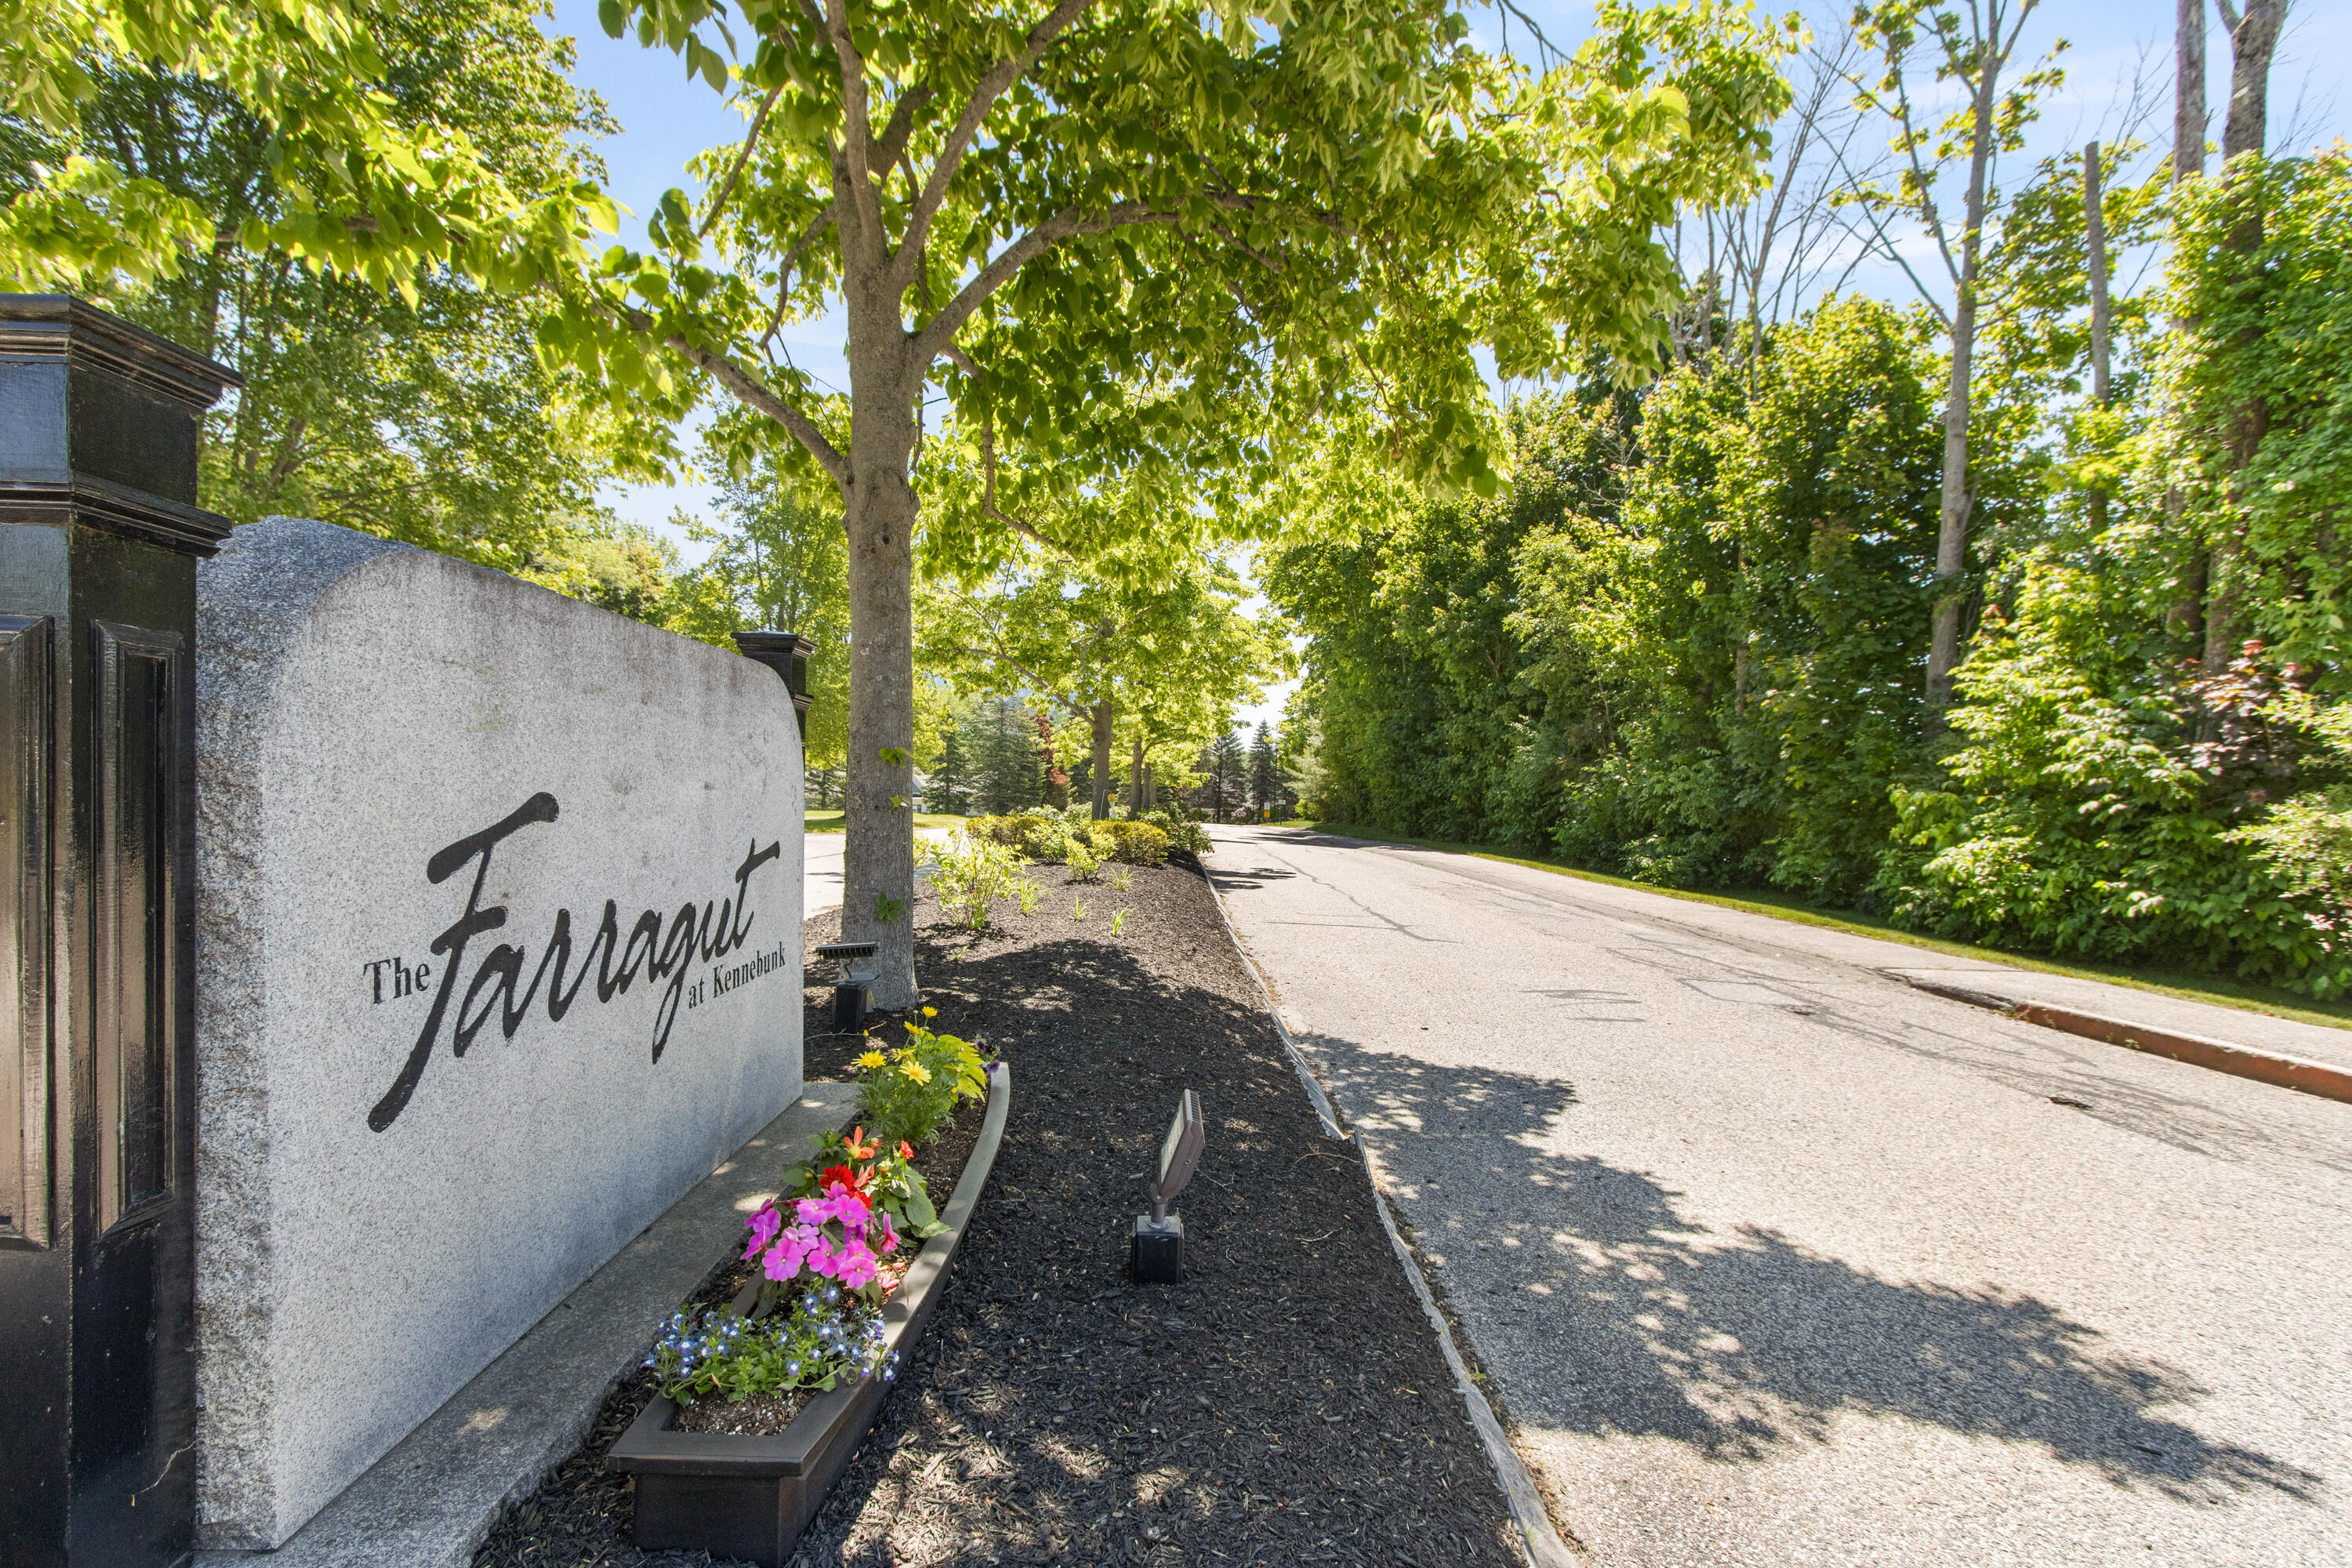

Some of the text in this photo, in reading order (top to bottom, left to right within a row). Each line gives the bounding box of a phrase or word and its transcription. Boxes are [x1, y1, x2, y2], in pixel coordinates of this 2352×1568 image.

[363, 791, 780, 1134] The Farragut
[688, 941, 786, 1010] at Kennebunk
